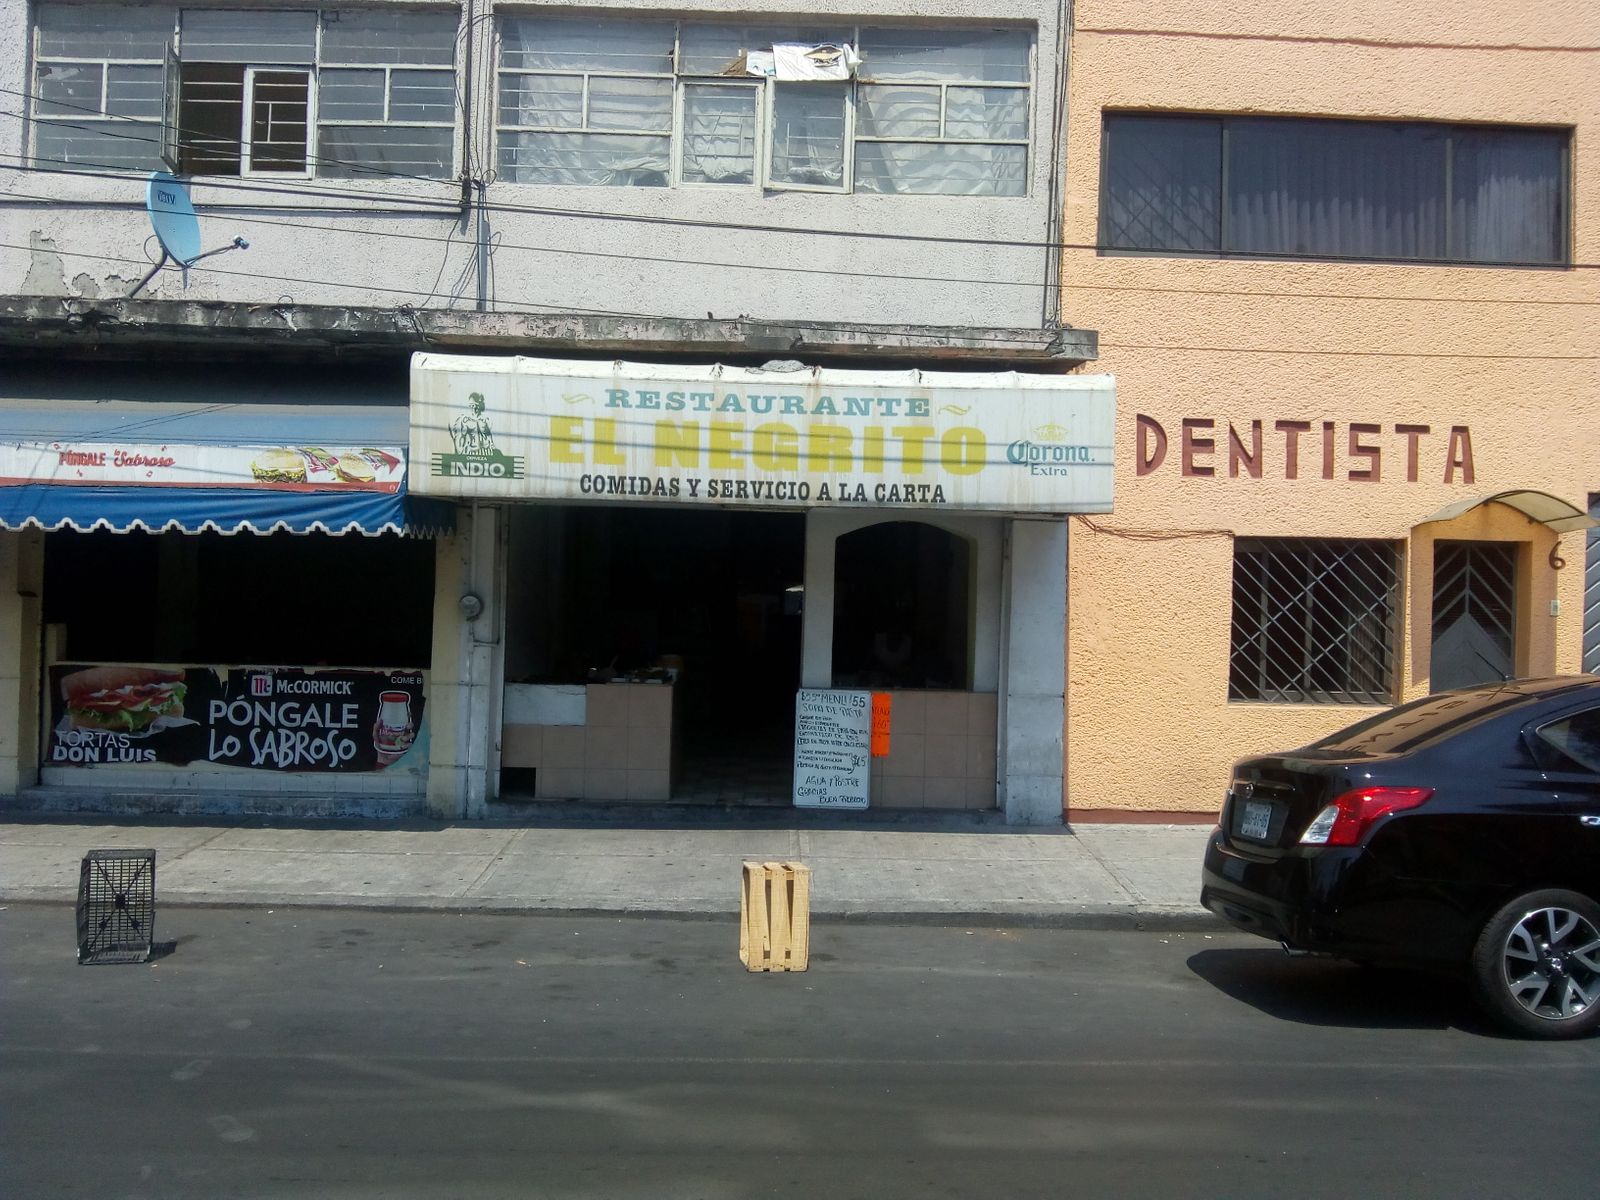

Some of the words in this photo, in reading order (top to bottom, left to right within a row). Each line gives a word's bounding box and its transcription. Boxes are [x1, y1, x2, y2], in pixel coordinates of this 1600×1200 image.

[605, 389, 930, 417] RESTAURANTE
[549, 415, 627, 465] EL
[655, 419, 987, 476] NEGRITO
[1136, 413, 1475, 484] DENTISTA
[450, 461, 506, 477] INDIO
[1031, 463, 1068, 476] Extra
[580, 474, 680, 496] COMIDAS
[687, 479, 702, 497] Y
[708, 479, 810, 501] SERVICIO
[816, 482, 833, 501] A
[838, 483, 868, 502] LA
[874, 483, 946, 503] CARTA
[1548, 541, 1567, 571] 6
[276, 680, 351, 695] McCORMICK
[391, 676, 416, 685] COME
[209, 695, 360, 728] PÓNGALE
[56, 730, 130, 749] TORTAS
[209, 729, 242, 760] LO
[249, 727, 357, 768] SABROSO
[52, 745, 100, 762] DON
[106, 747, 157, 763] LUIS
